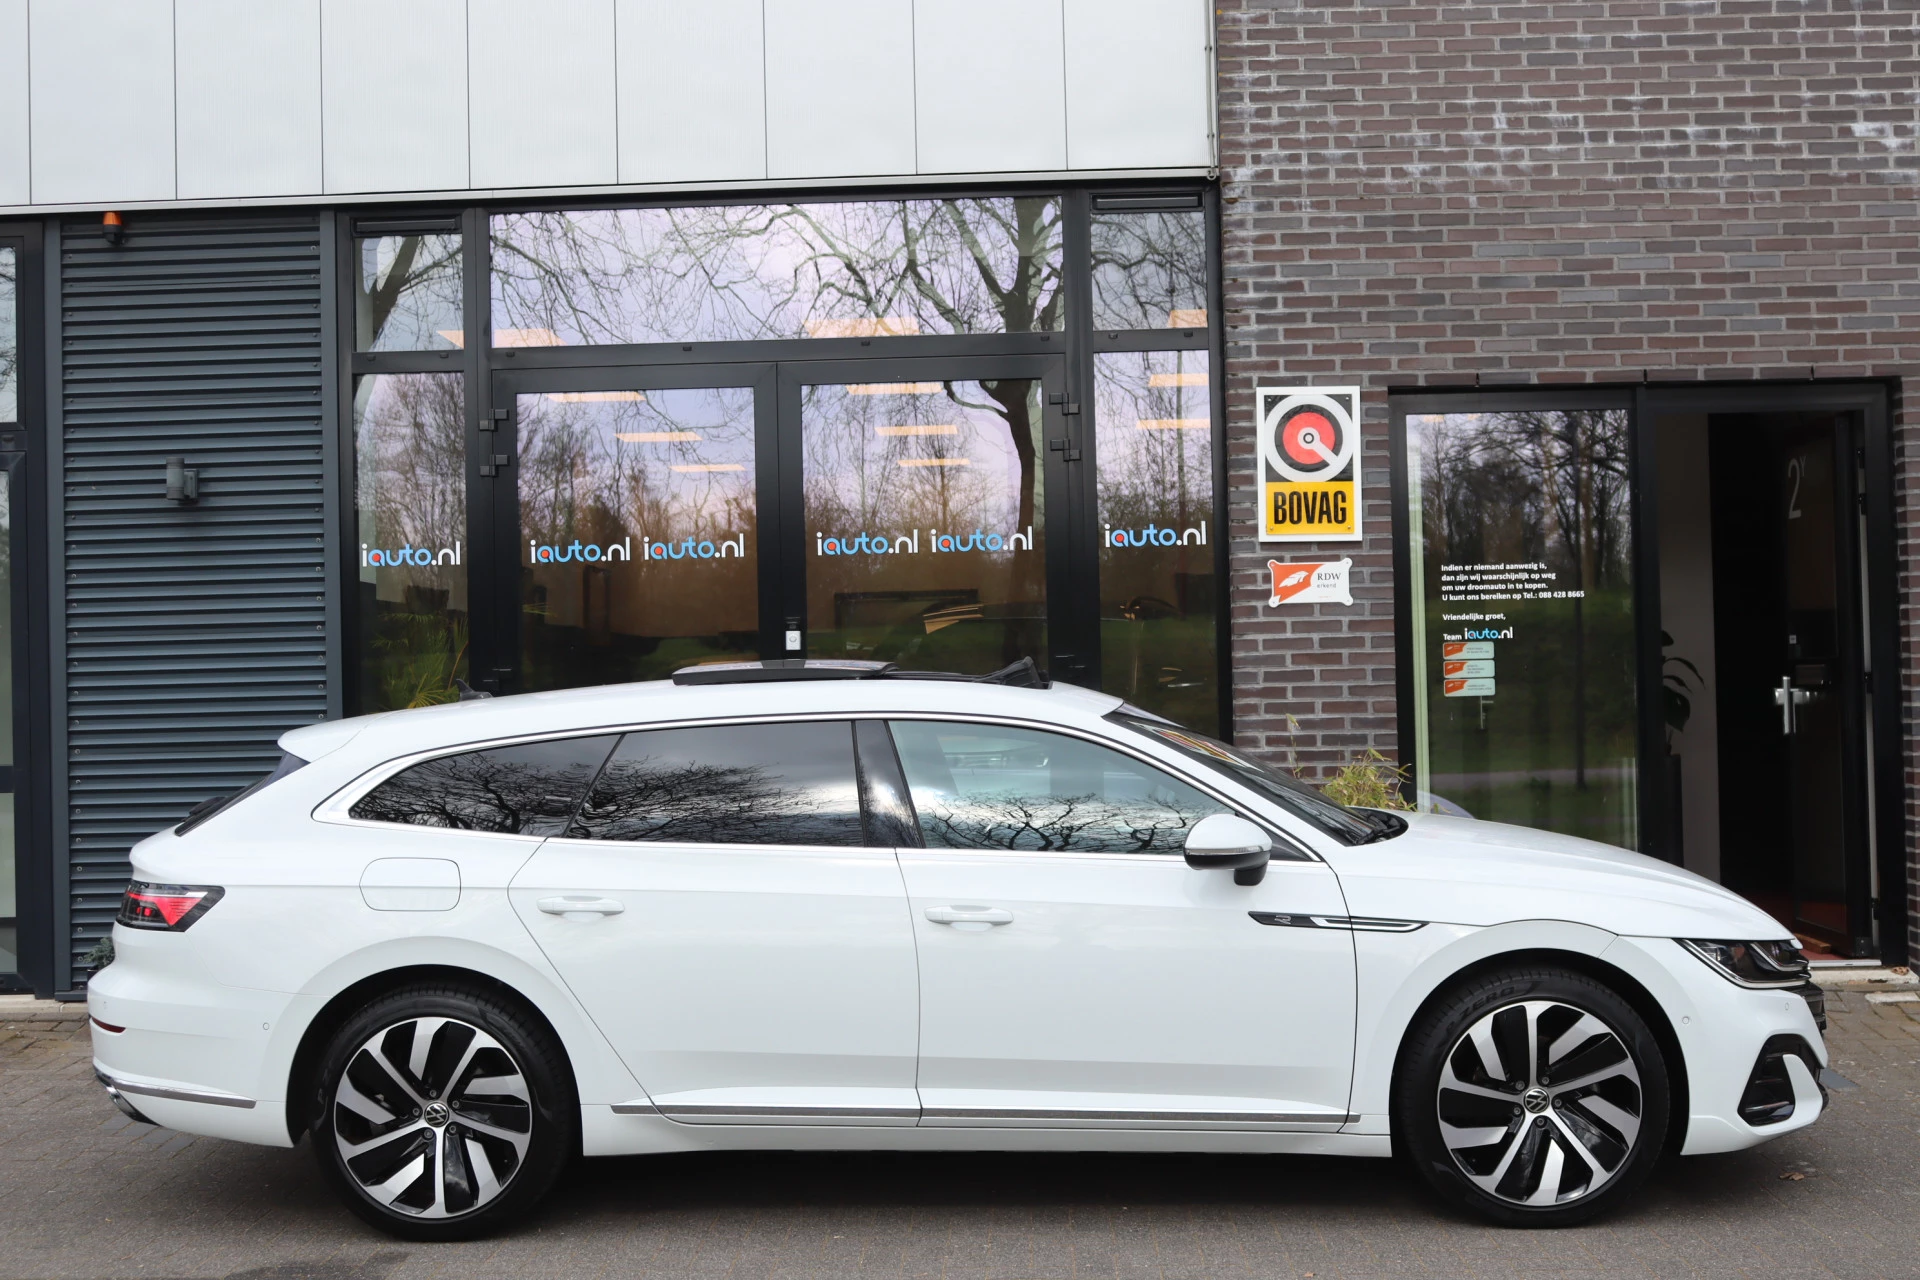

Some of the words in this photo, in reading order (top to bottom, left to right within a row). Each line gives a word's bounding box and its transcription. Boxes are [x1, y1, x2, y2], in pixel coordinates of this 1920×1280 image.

[1273, 490, 1347, 525] BOVAG
[644, 533, 745, 560] iauto.nl
[817, 529, 919, 556] iauto.nl
[931, 526, 1033, 553] iauto.nl
[1104, 520, 1207, 548] iauto.nl
[362, 541, 461, 568] iauto.nl
[530, 537, 630, 564] iauto.nl
[1317, 572, 1342, 581] RDW
[1470, 573, 1480, 581] wij
[1482, 572, 1529, 580] waarschijnlijk
[1541, 572, 1556, 580] weg
[1505, 562, 1538, 570] aanwezig
[1539, 562, 1547, 570] is,
[1524, 582, 1548, 590] kopen.
[1443, 613, 1484, 621] Vriendelijke
[1485, 613, 1506, 621] groet,
[1465, 627, 1513, 640] iauto.nl
